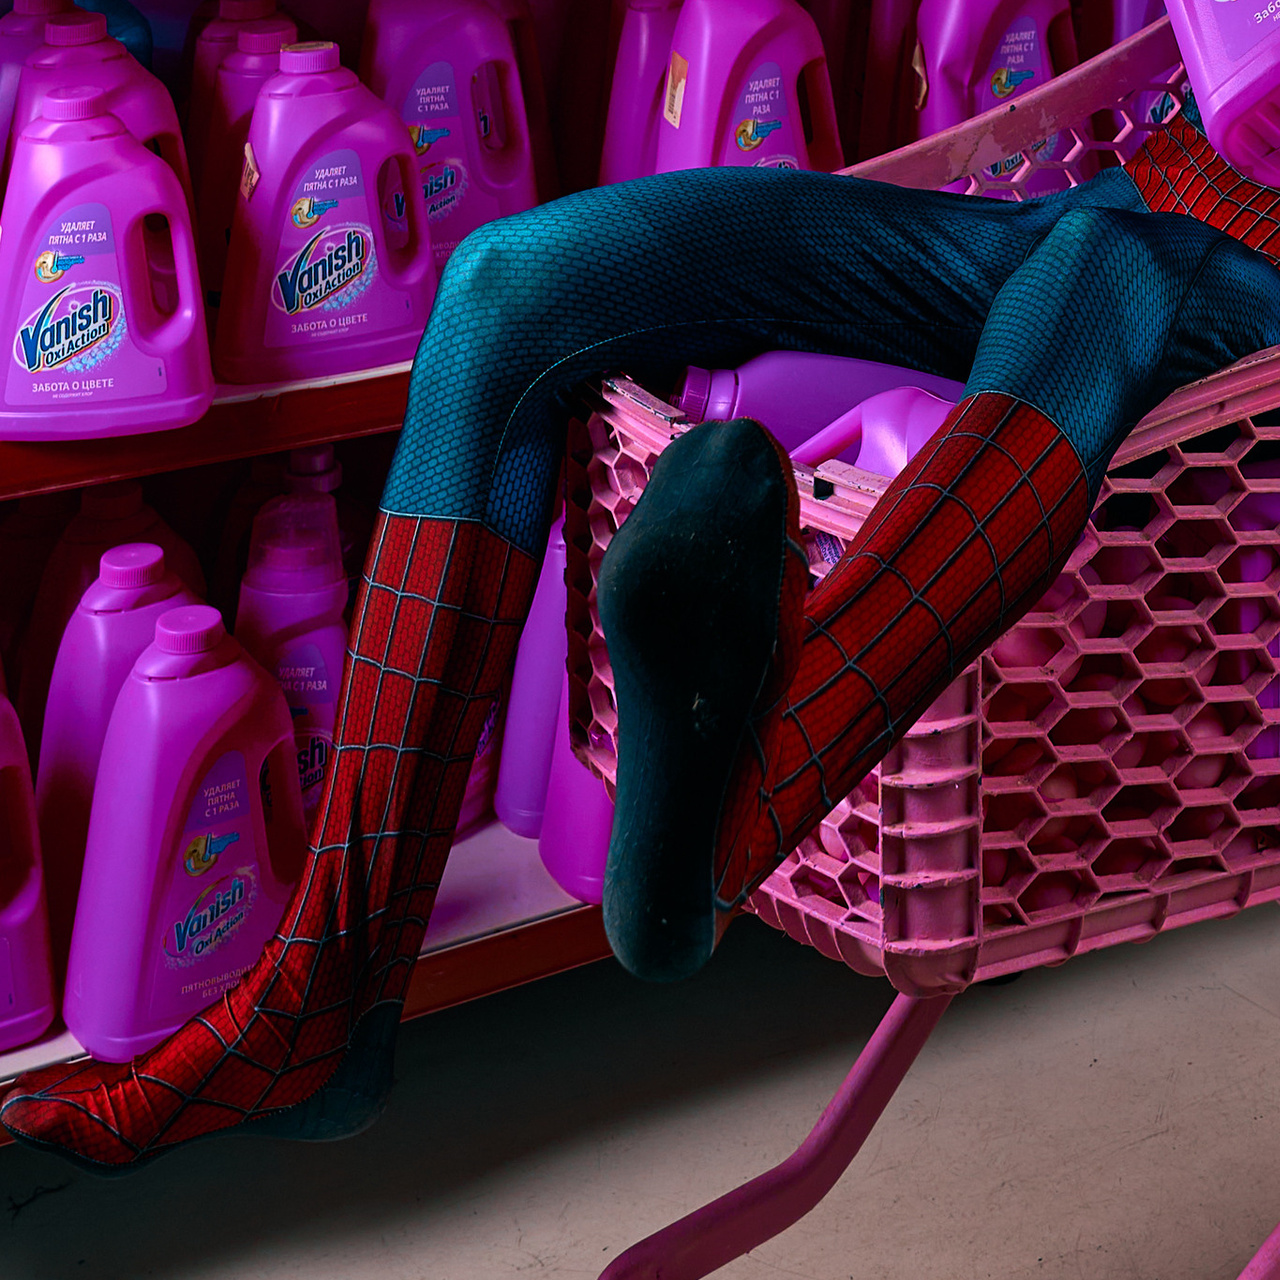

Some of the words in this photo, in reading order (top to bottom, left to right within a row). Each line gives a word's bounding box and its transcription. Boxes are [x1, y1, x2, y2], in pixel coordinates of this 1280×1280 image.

[749, 78, 780, 91] УДАЛЯЕТ
[745, 93, 768, 104] ПЯТНА
[769, 92, 775, 100] С
[775, 90, 779, 99] 1
[753, 104, 771, 115] РАЗА
[315, 166, 347, 178] УДАЛЯЕТ
[303, 180, 327, 192] ПЯТНА
[328, 180, 333, 189] С
[335, 179, 338, 187] 1
[339, 176, 357, 187] РАЗА
[429, 195, 455, 215] Action
[60, 221, 95, 232] УДАЛЯЕТ
[49, 236, 73, 245] ПЯТНА
[75, 235, 81, 243] С
[82, 233, 86, 242] 1
[88, 232, 107, 242] РАЗА
[278, 227, 365, 315] Vanish
[303, 288, 323, 307] Oxi
[325, 261, 361, 294] Action
[20, 284, 112, 373] Vanish
[291, 321, 327, 334] ЗАБОТА
[330, 319, 336, 328] О
[338, 313, 368, 328] ЦВЕТЕ
[45, 347, 65, 366] Oxi
[67, 323, 109, 352] Action
[32, 381, 70, 393] ЗАБОТА
[72, 381, 80, 389] О
[82, 378, 114, 389] ЦВЕТЕ
[203, 779, 241, 798] УДАЛЯЕТ
[207, 792, 236, 806] ПЯТНА
[205, 808, 211, 817] С
[213, 807, 217, 816] 1
[219, 801, 240, 813] РАЗА
[174, 875, 244, 952] Vanish
[195, 931, 214, 955] Oxi
[215, 911, 244, 939] Action
